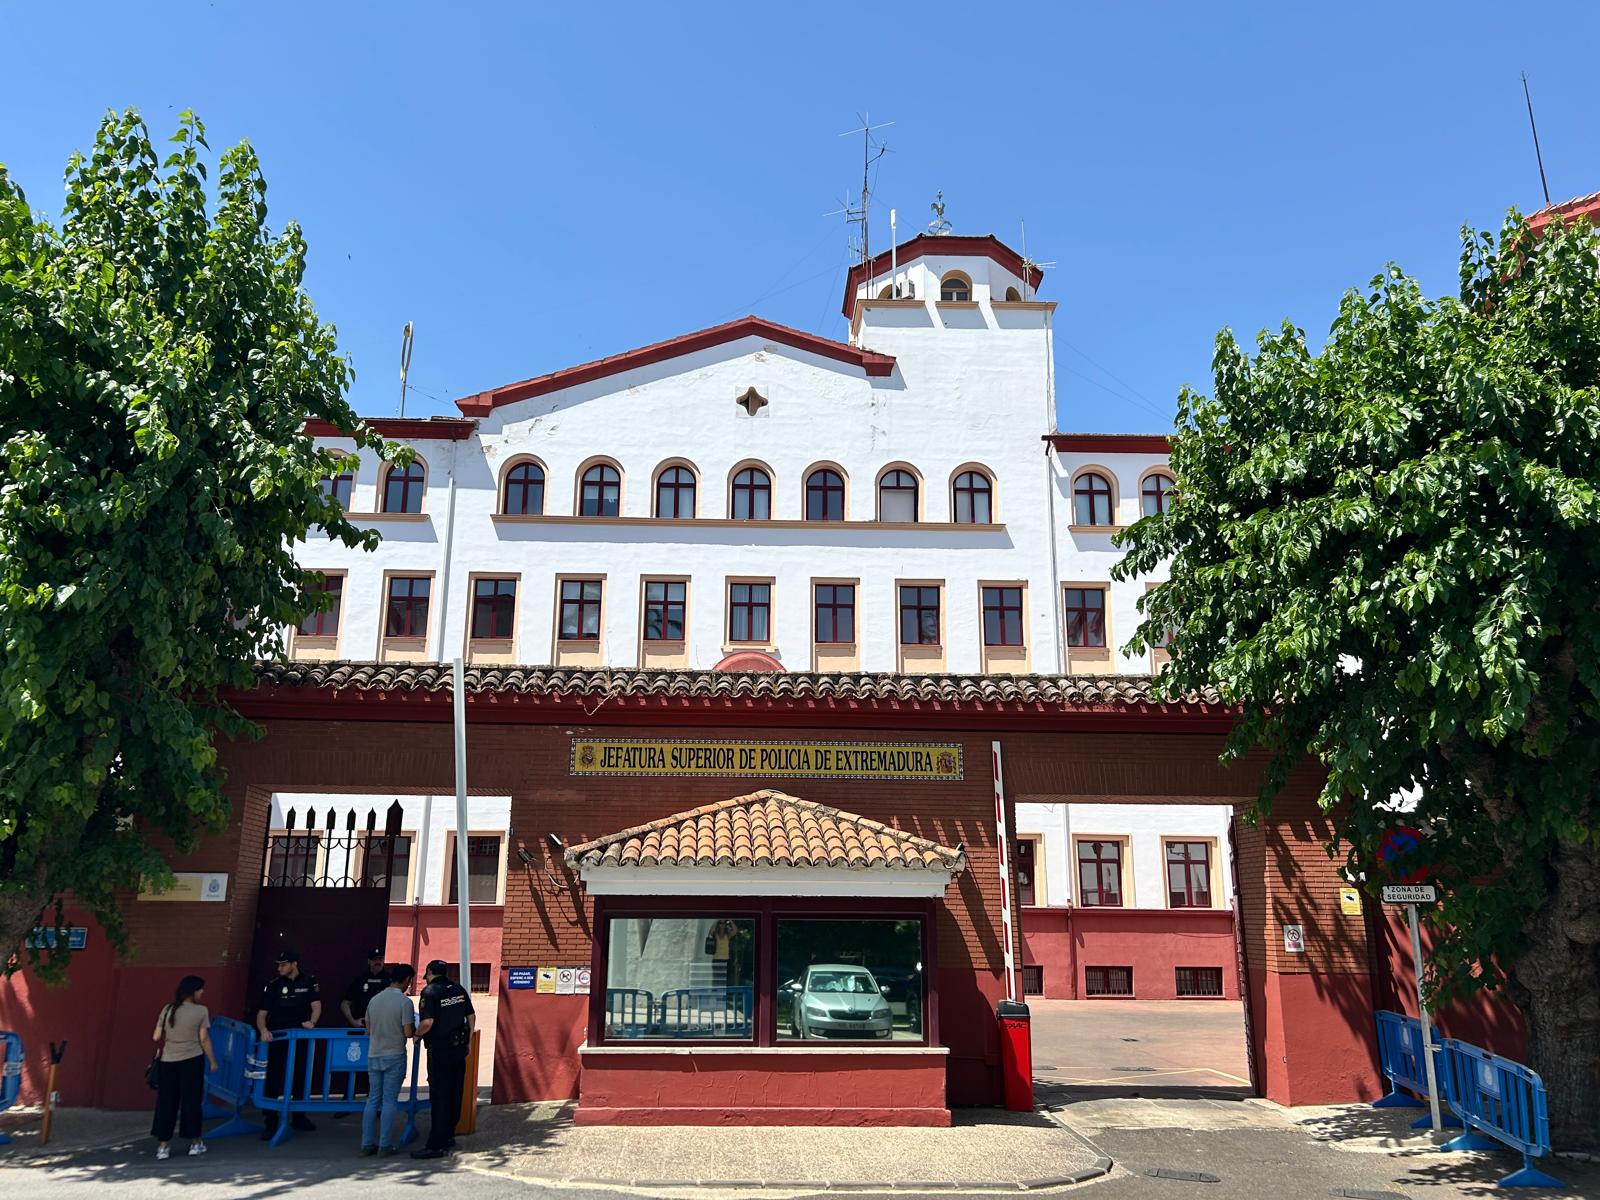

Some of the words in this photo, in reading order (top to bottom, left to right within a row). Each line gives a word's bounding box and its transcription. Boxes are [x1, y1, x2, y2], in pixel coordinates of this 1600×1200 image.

[600, 746, 666, 769] JEFATURA
[670, 747, 735, 770] SUPERIOR
[739, 748, 757, 770] DE
[760, 748, 811, 770] POLICIA
[815, 749, 832, 771] DE
[835, 750, 933, 772] EXTREMADURA
